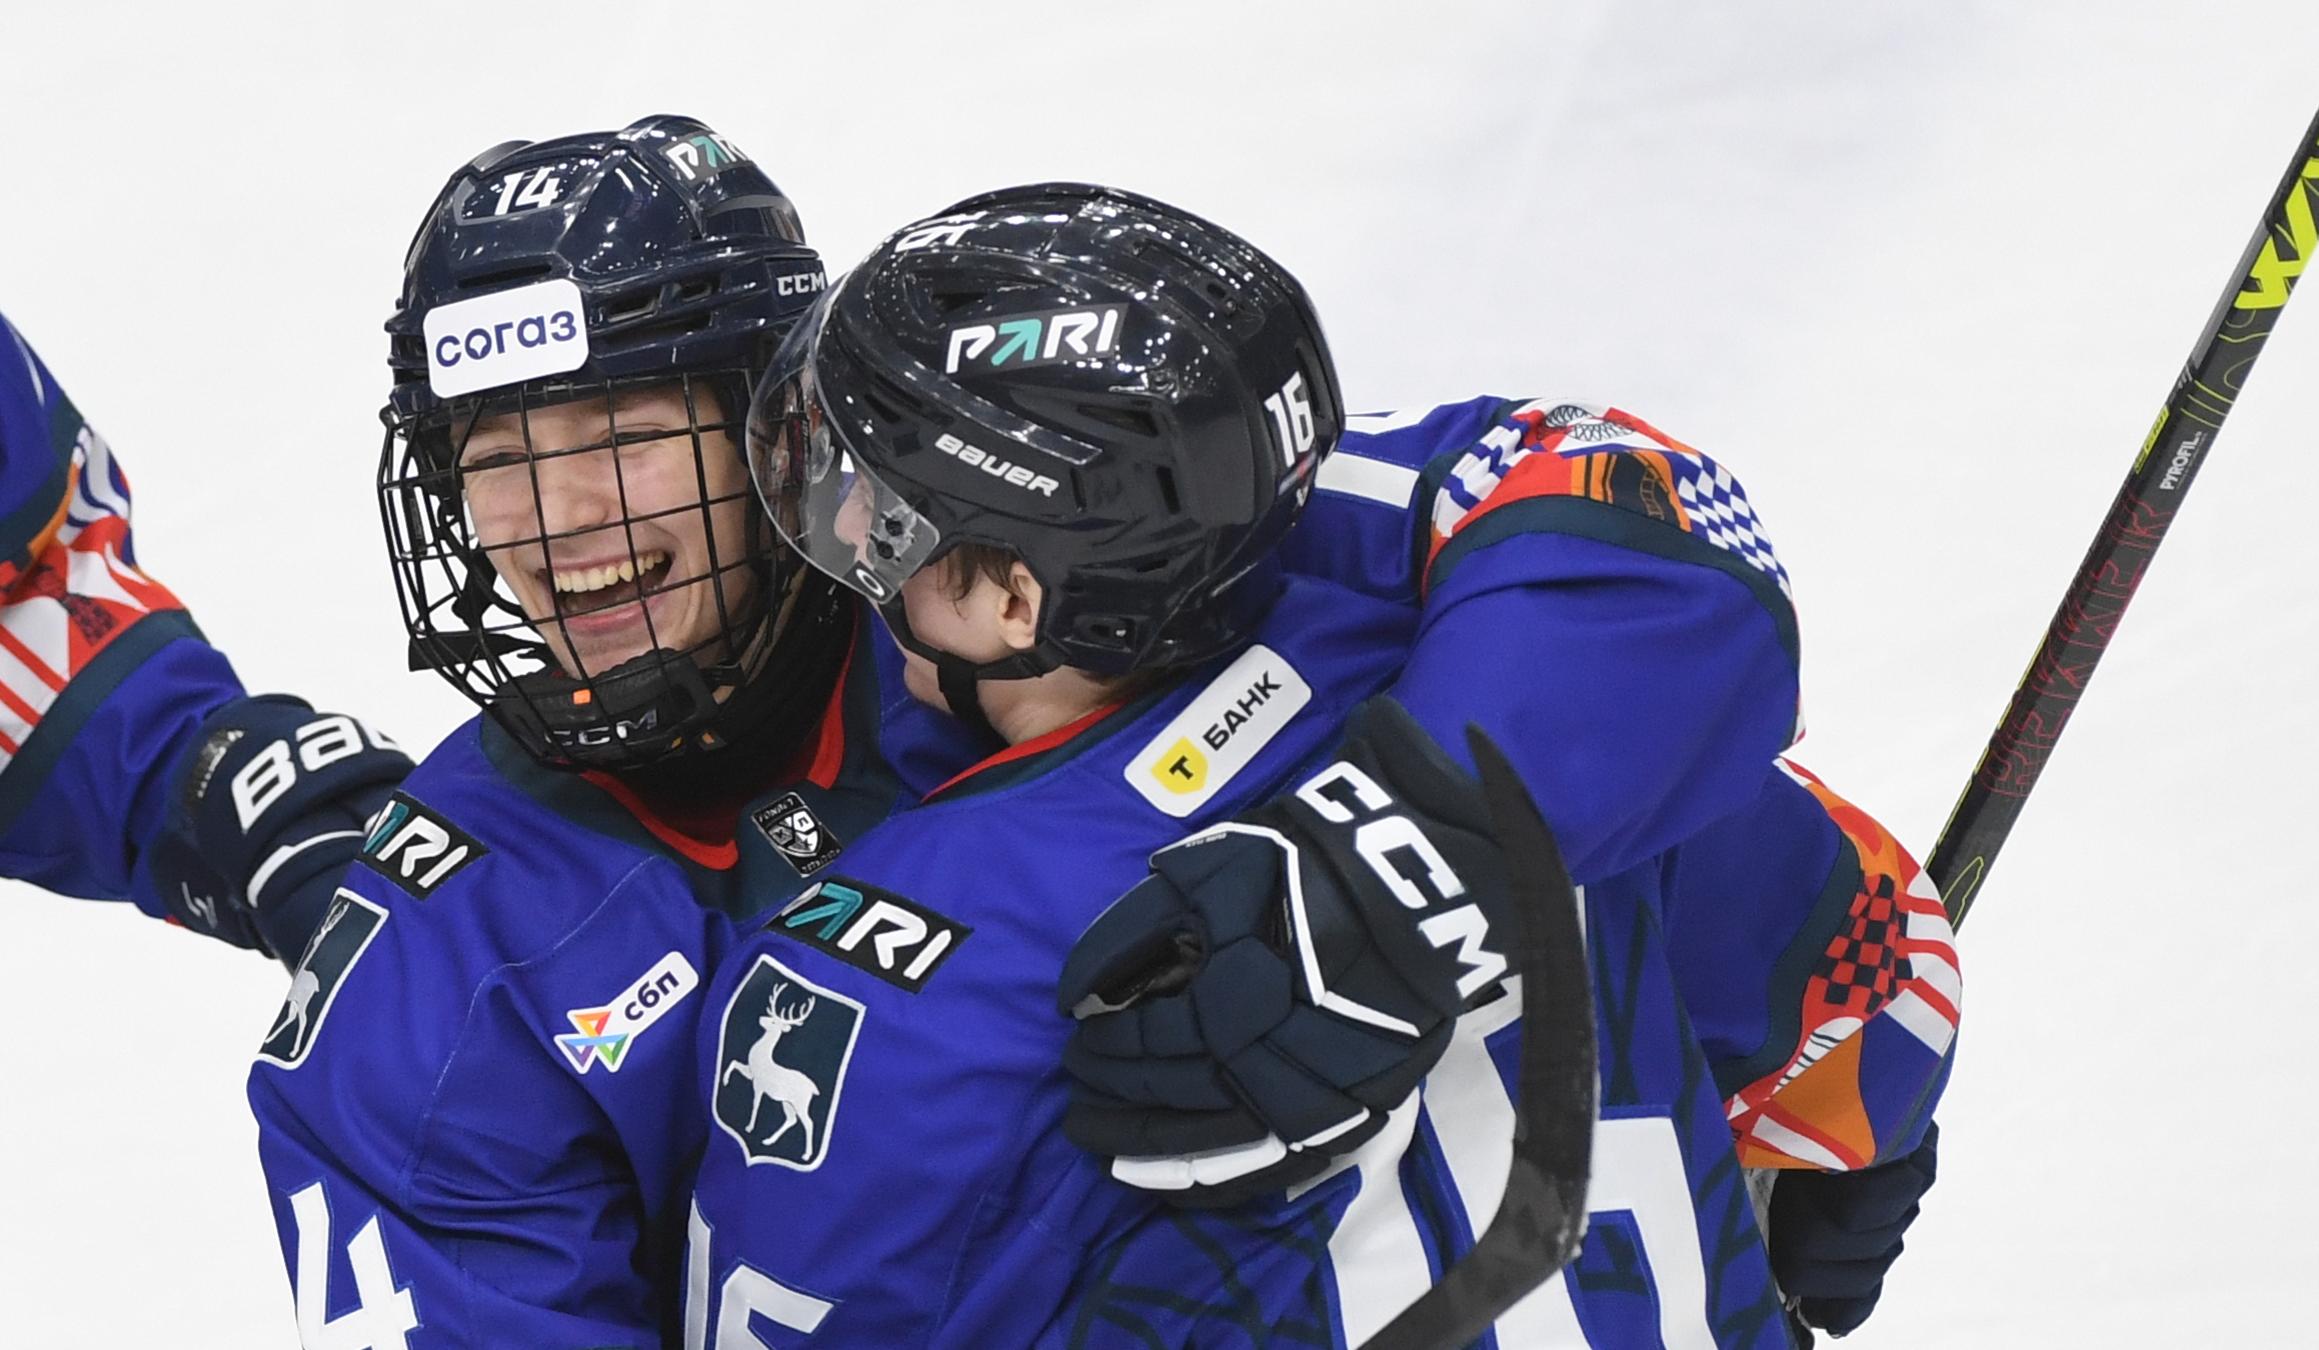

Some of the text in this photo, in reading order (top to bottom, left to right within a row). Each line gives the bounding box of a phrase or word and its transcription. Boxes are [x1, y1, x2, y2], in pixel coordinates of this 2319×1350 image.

[666, 133, 751, 181] PAR
[493, 166, 559, 216] 14
[776, 272, 825, 297] CCM
[435, 309, 578, 368] согаз
[945, 309, 1120, 374] PARI
[1264, 370, 1315, 468] 16
[2159, 435, 2200, 490] PYROFIL
[1203, 671, 1283, 751] БАНК
[1296, 760, 1508, 999] CCM
[624, 971, 680, 1021] сбп
